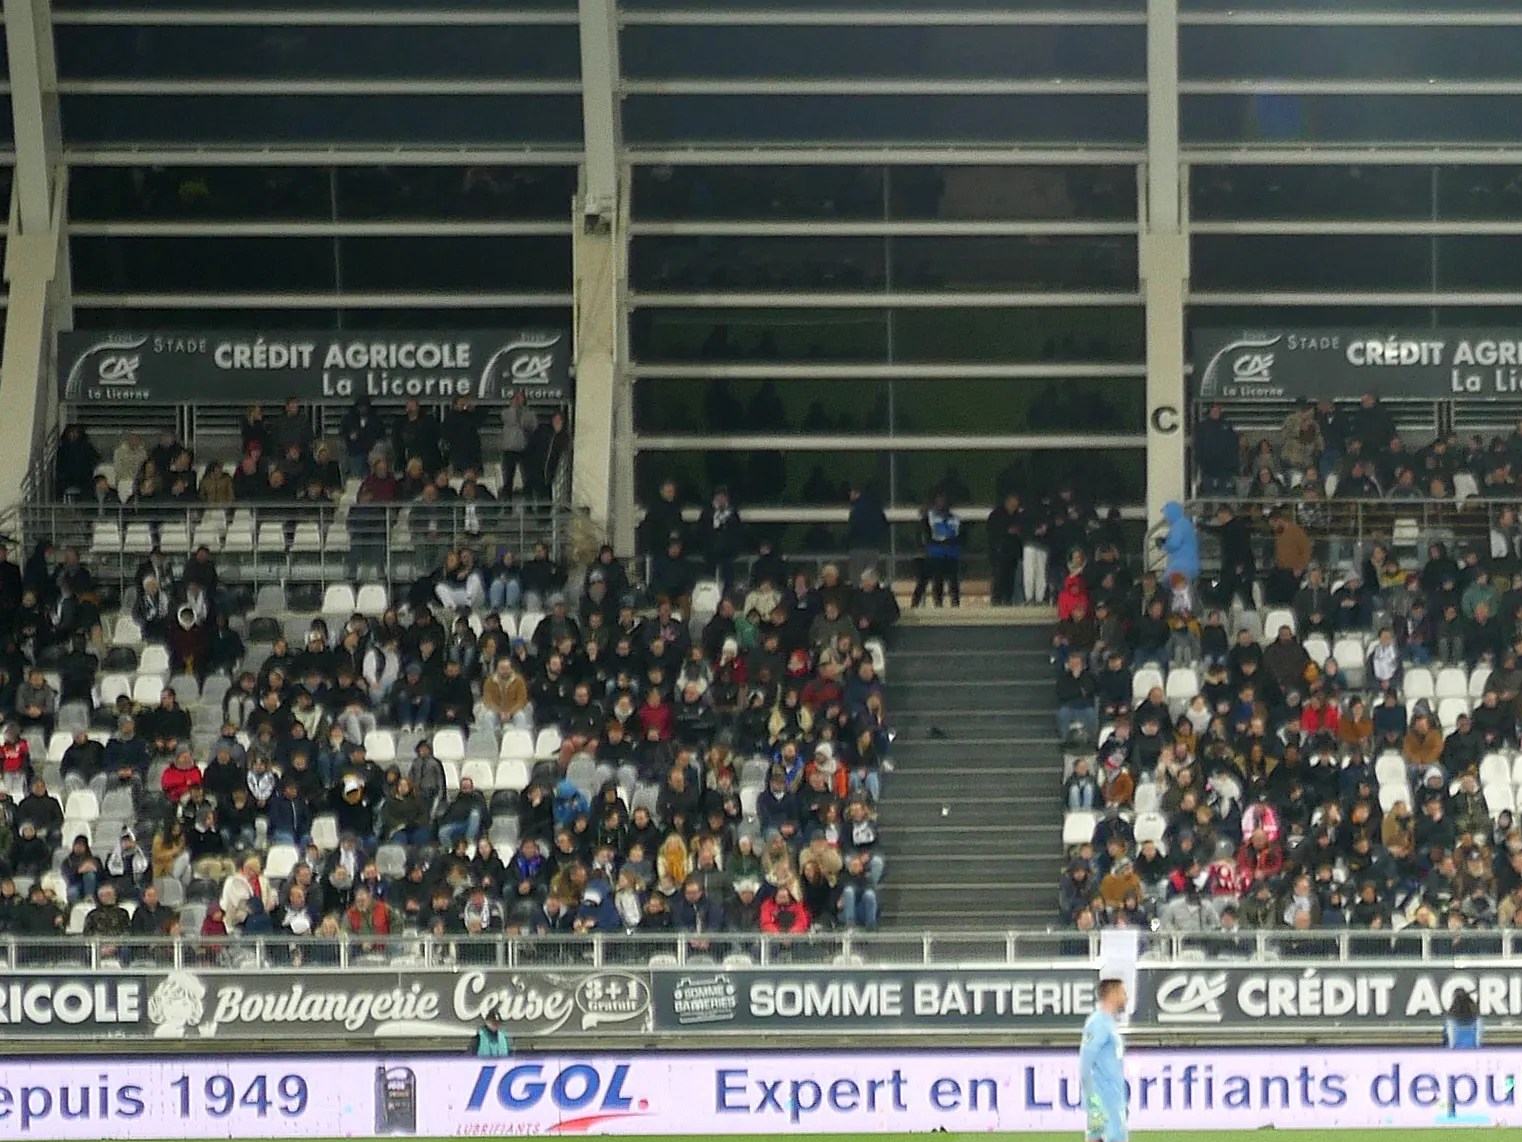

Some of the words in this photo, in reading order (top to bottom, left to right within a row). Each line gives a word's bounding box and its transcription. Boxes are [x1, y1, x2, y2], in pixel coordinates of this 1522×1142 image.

[153, 337, 207, 353] STADE
[214, 338, 314, 369] CRÉDIT
[323, 342, 471, 369] AGRICOLE
[1287, 334, 1340, 350] STADE
[1346, 335, 1444, 366] CRÉDIT
[323, 372, 352, 396] La
[367, 371, 471, 396] Licorne
[1452, 370, 1482, 393] La
[1151, 406, 1179, 434] C
[585, 979, 638, 1001] 3+1
[749, 980, 902, 1017] SOMME
[914, 979, 1100, 1016] BATTERIE
[1237, 967, 1397, 1017] CRÉDIT
[212, 983, 440, 1032] Boulangerie
[170, 1073, 309, 1119] 1949
[715, 1069, 907, 1123] Expert
[928, 1079, 998, 1112] en
[1024, 1063, 1347, 1113] Lurifiants
